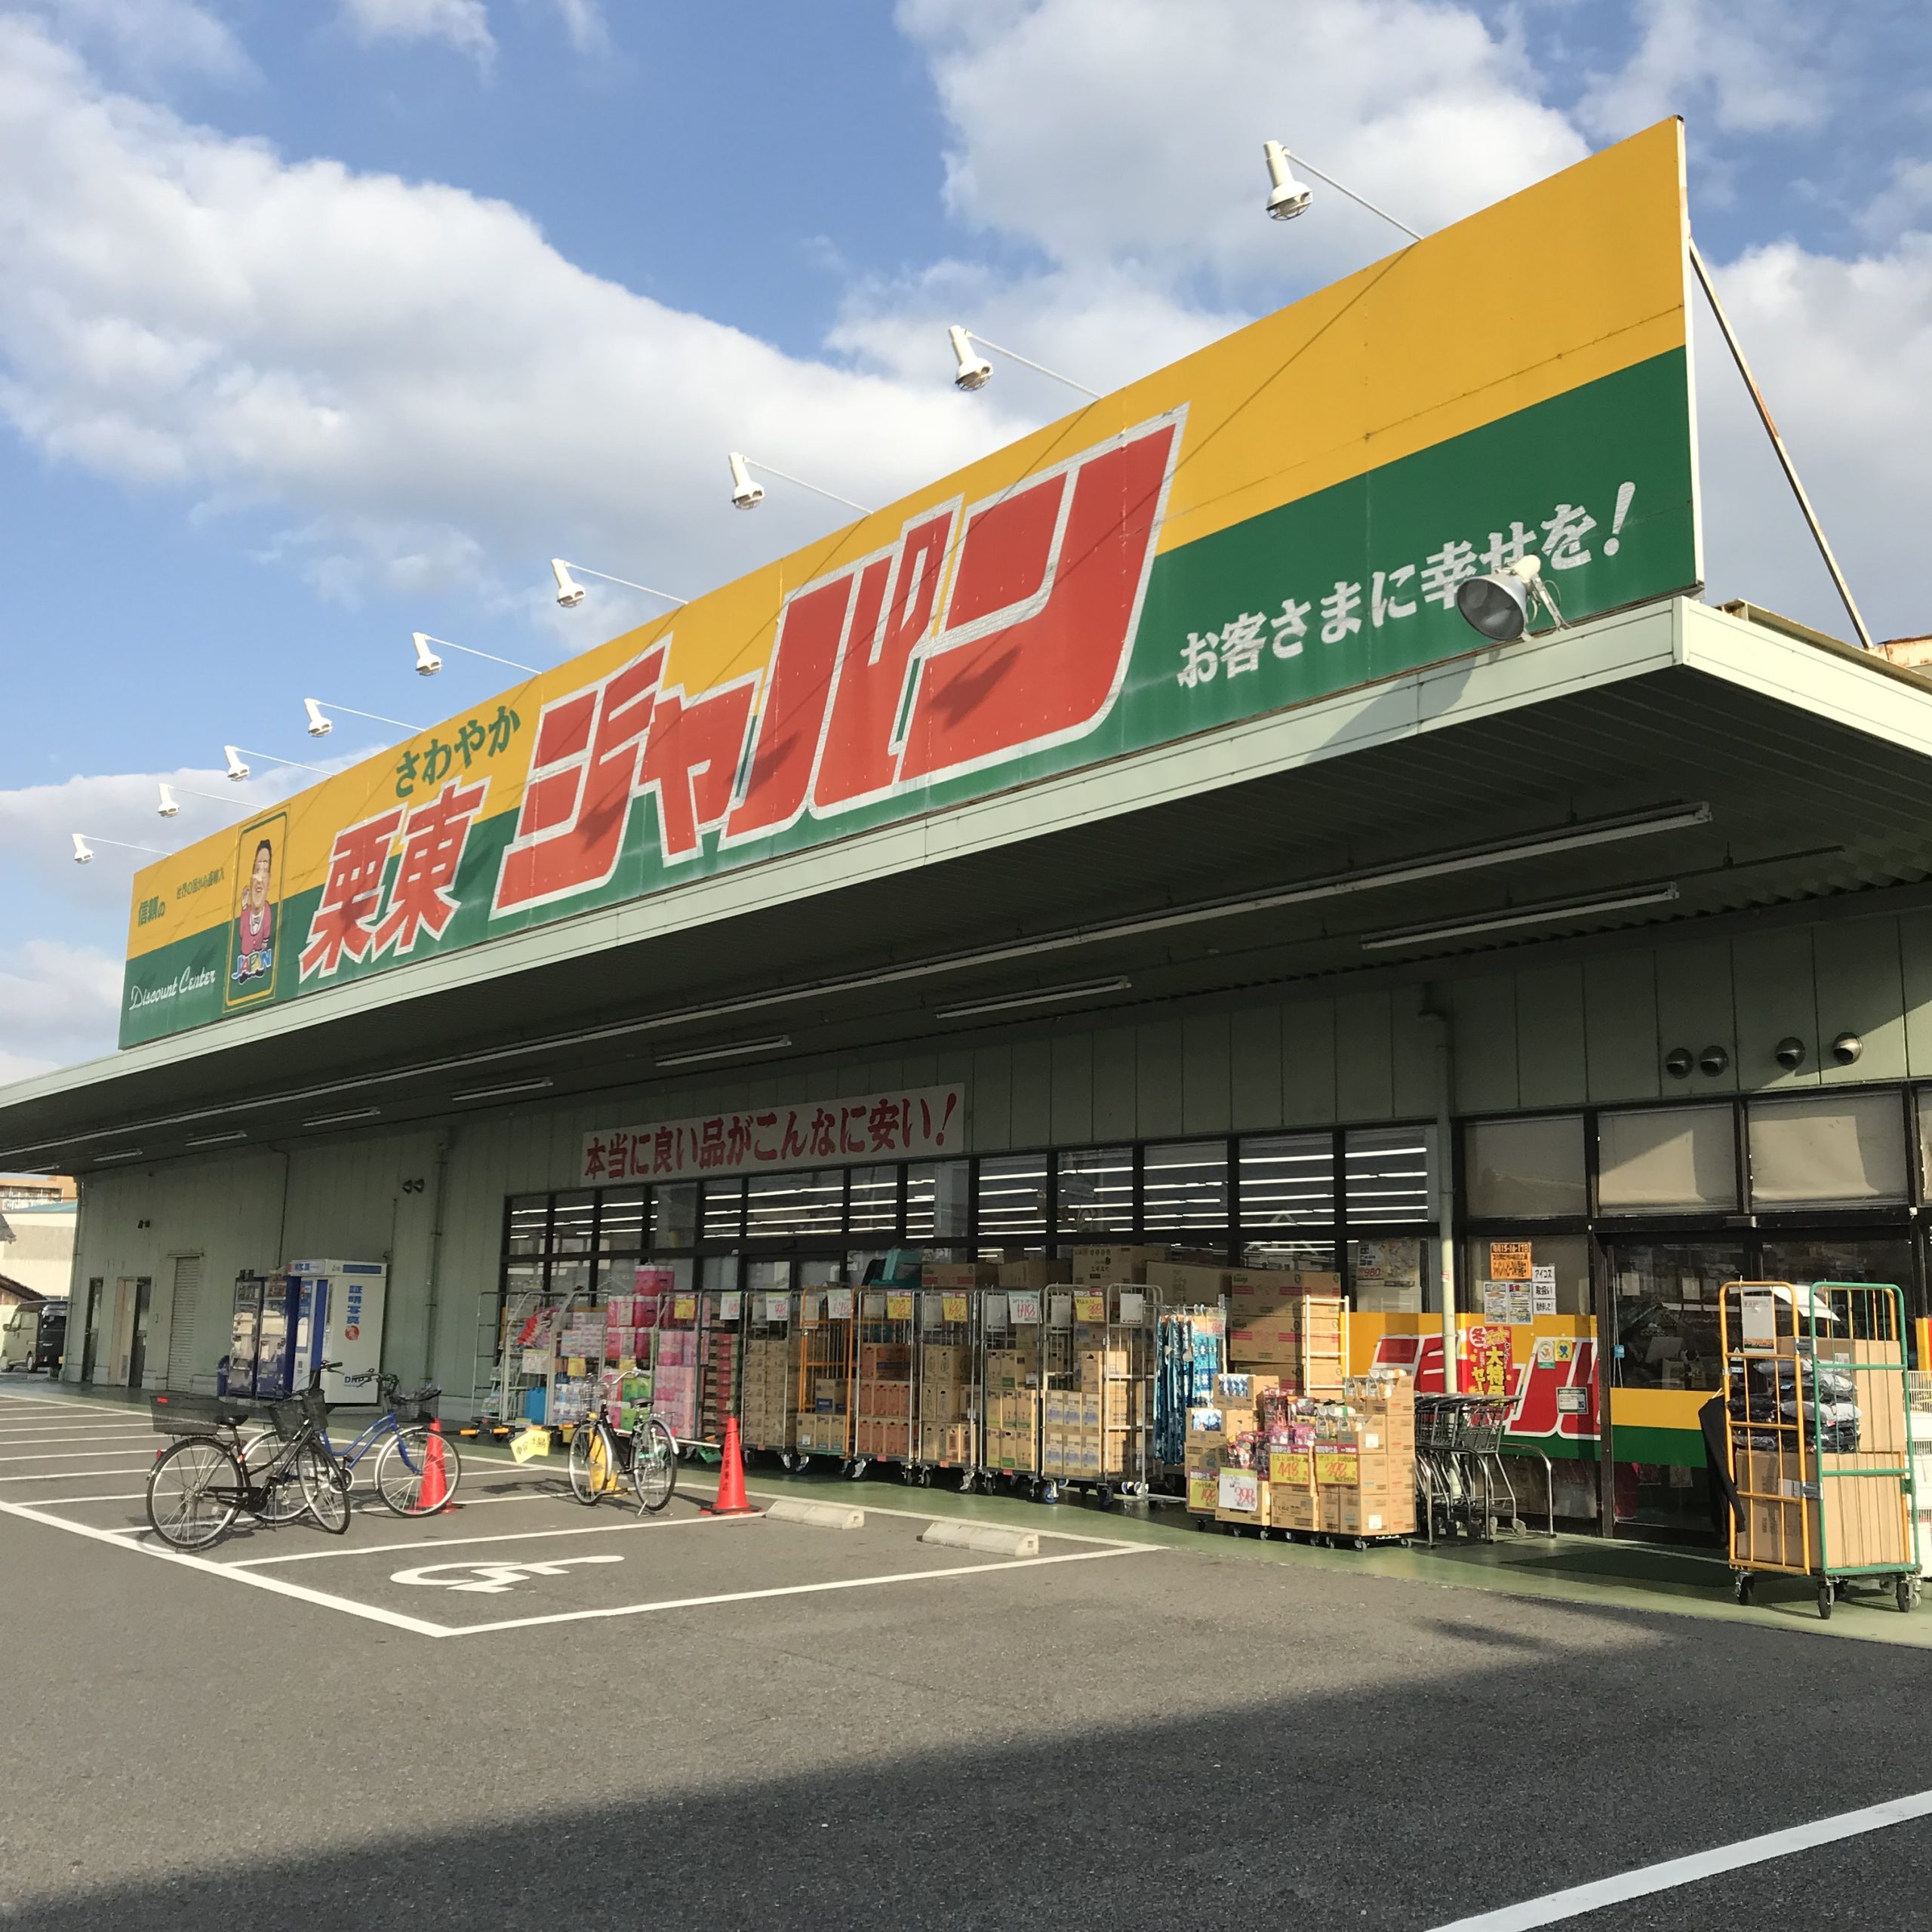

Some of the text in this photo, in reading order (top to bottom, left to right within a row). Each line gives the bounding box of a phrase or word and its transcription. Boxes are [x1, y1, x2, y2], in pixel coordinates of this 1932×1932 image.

[395, 706, 521, 798] さわやか
[299, 775, 492, 984] 栗東
[231, 949, 272, 980] JAPAN
[129, 966, 216, 1011] Discount Center
[585, 1093, 957, 1180] 本当に良い品がこんなに安い!
[1534, 1269, 1552, 1278] アイコス
[346, 1285, 363, 1324] 証明写真
[1472, 1327, 1485, 1344] 冬
